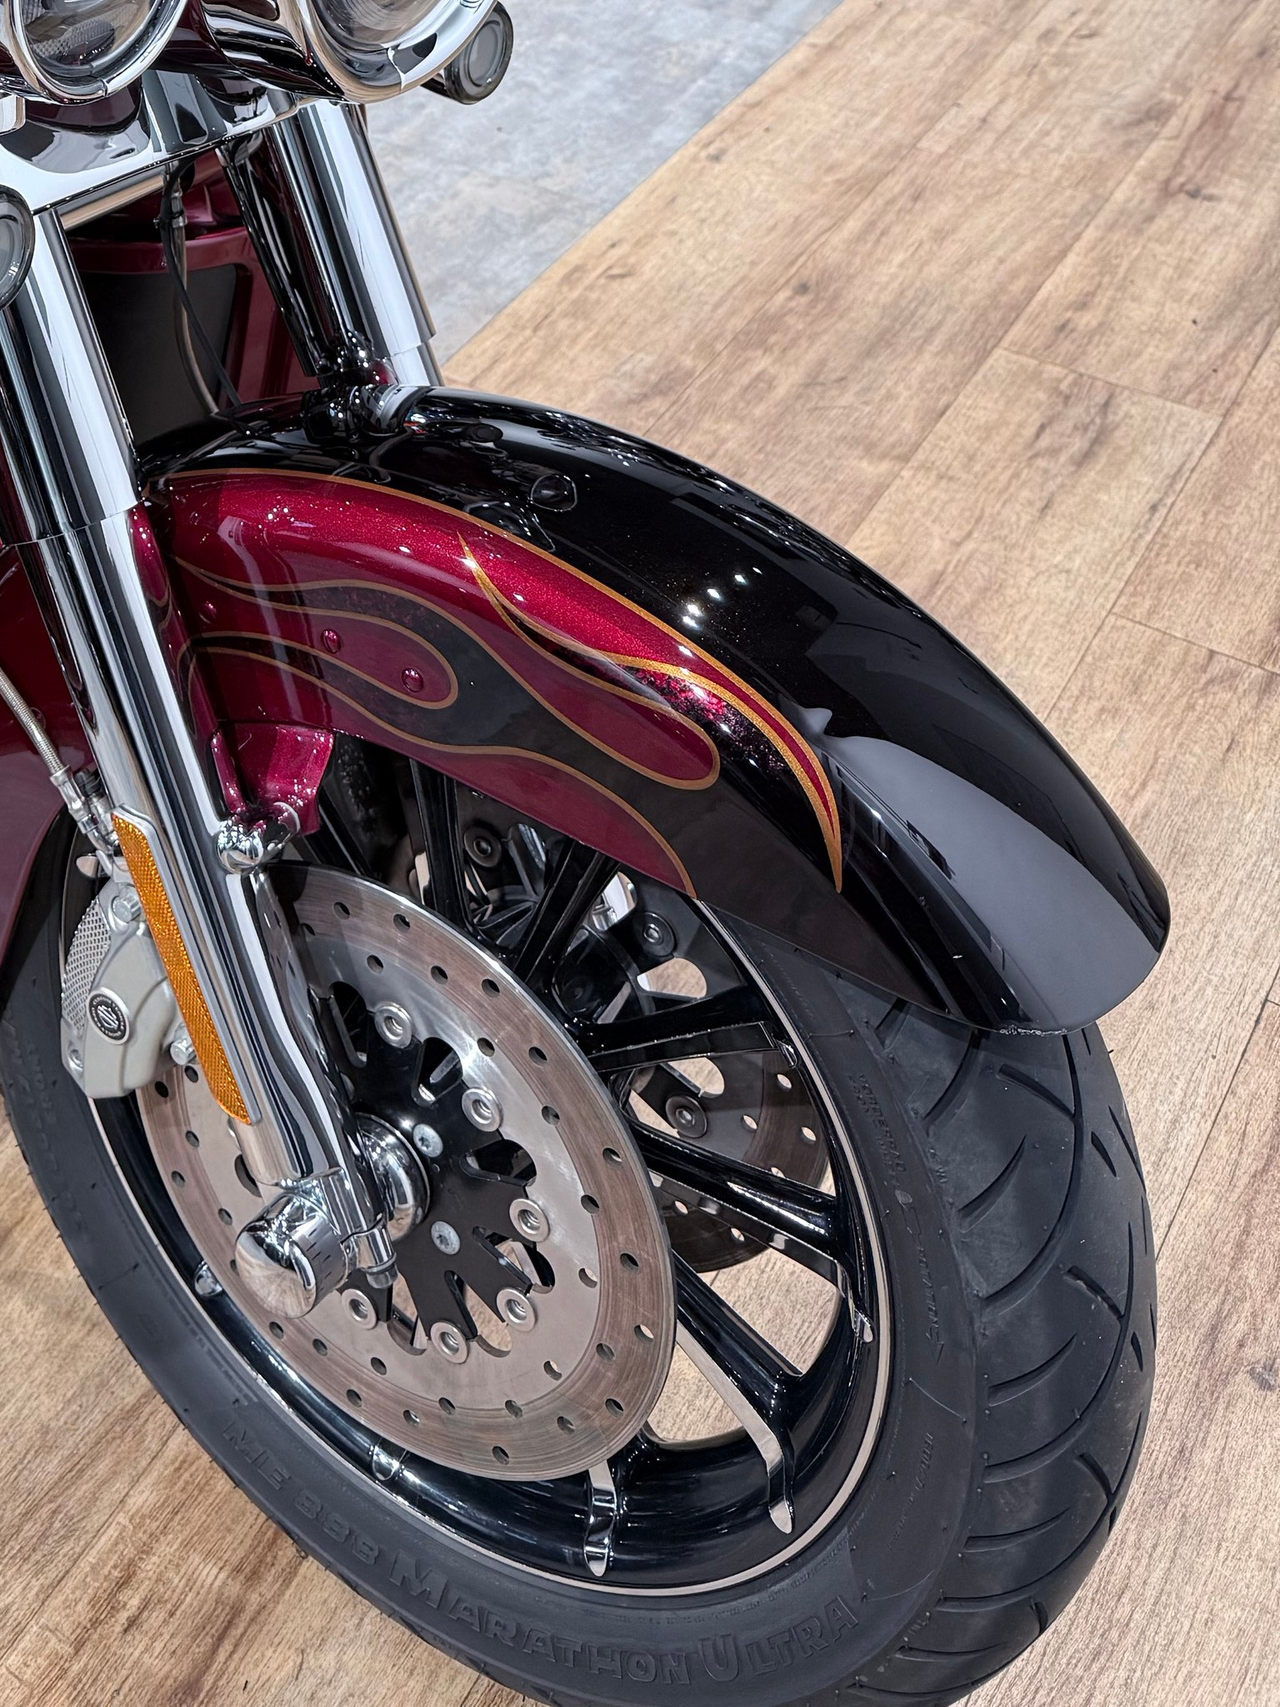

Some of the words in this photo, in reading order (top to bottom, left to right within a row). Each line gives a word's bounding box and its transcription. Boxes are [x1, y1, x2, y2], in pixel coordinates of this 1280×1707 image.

[222, 1420, 291, 1492] ME
[294, 1490, 382, 1566] 888
[388, 1548, 692, 1686] MARATHON
[697, 1593, 859, 1682] ULTRA
